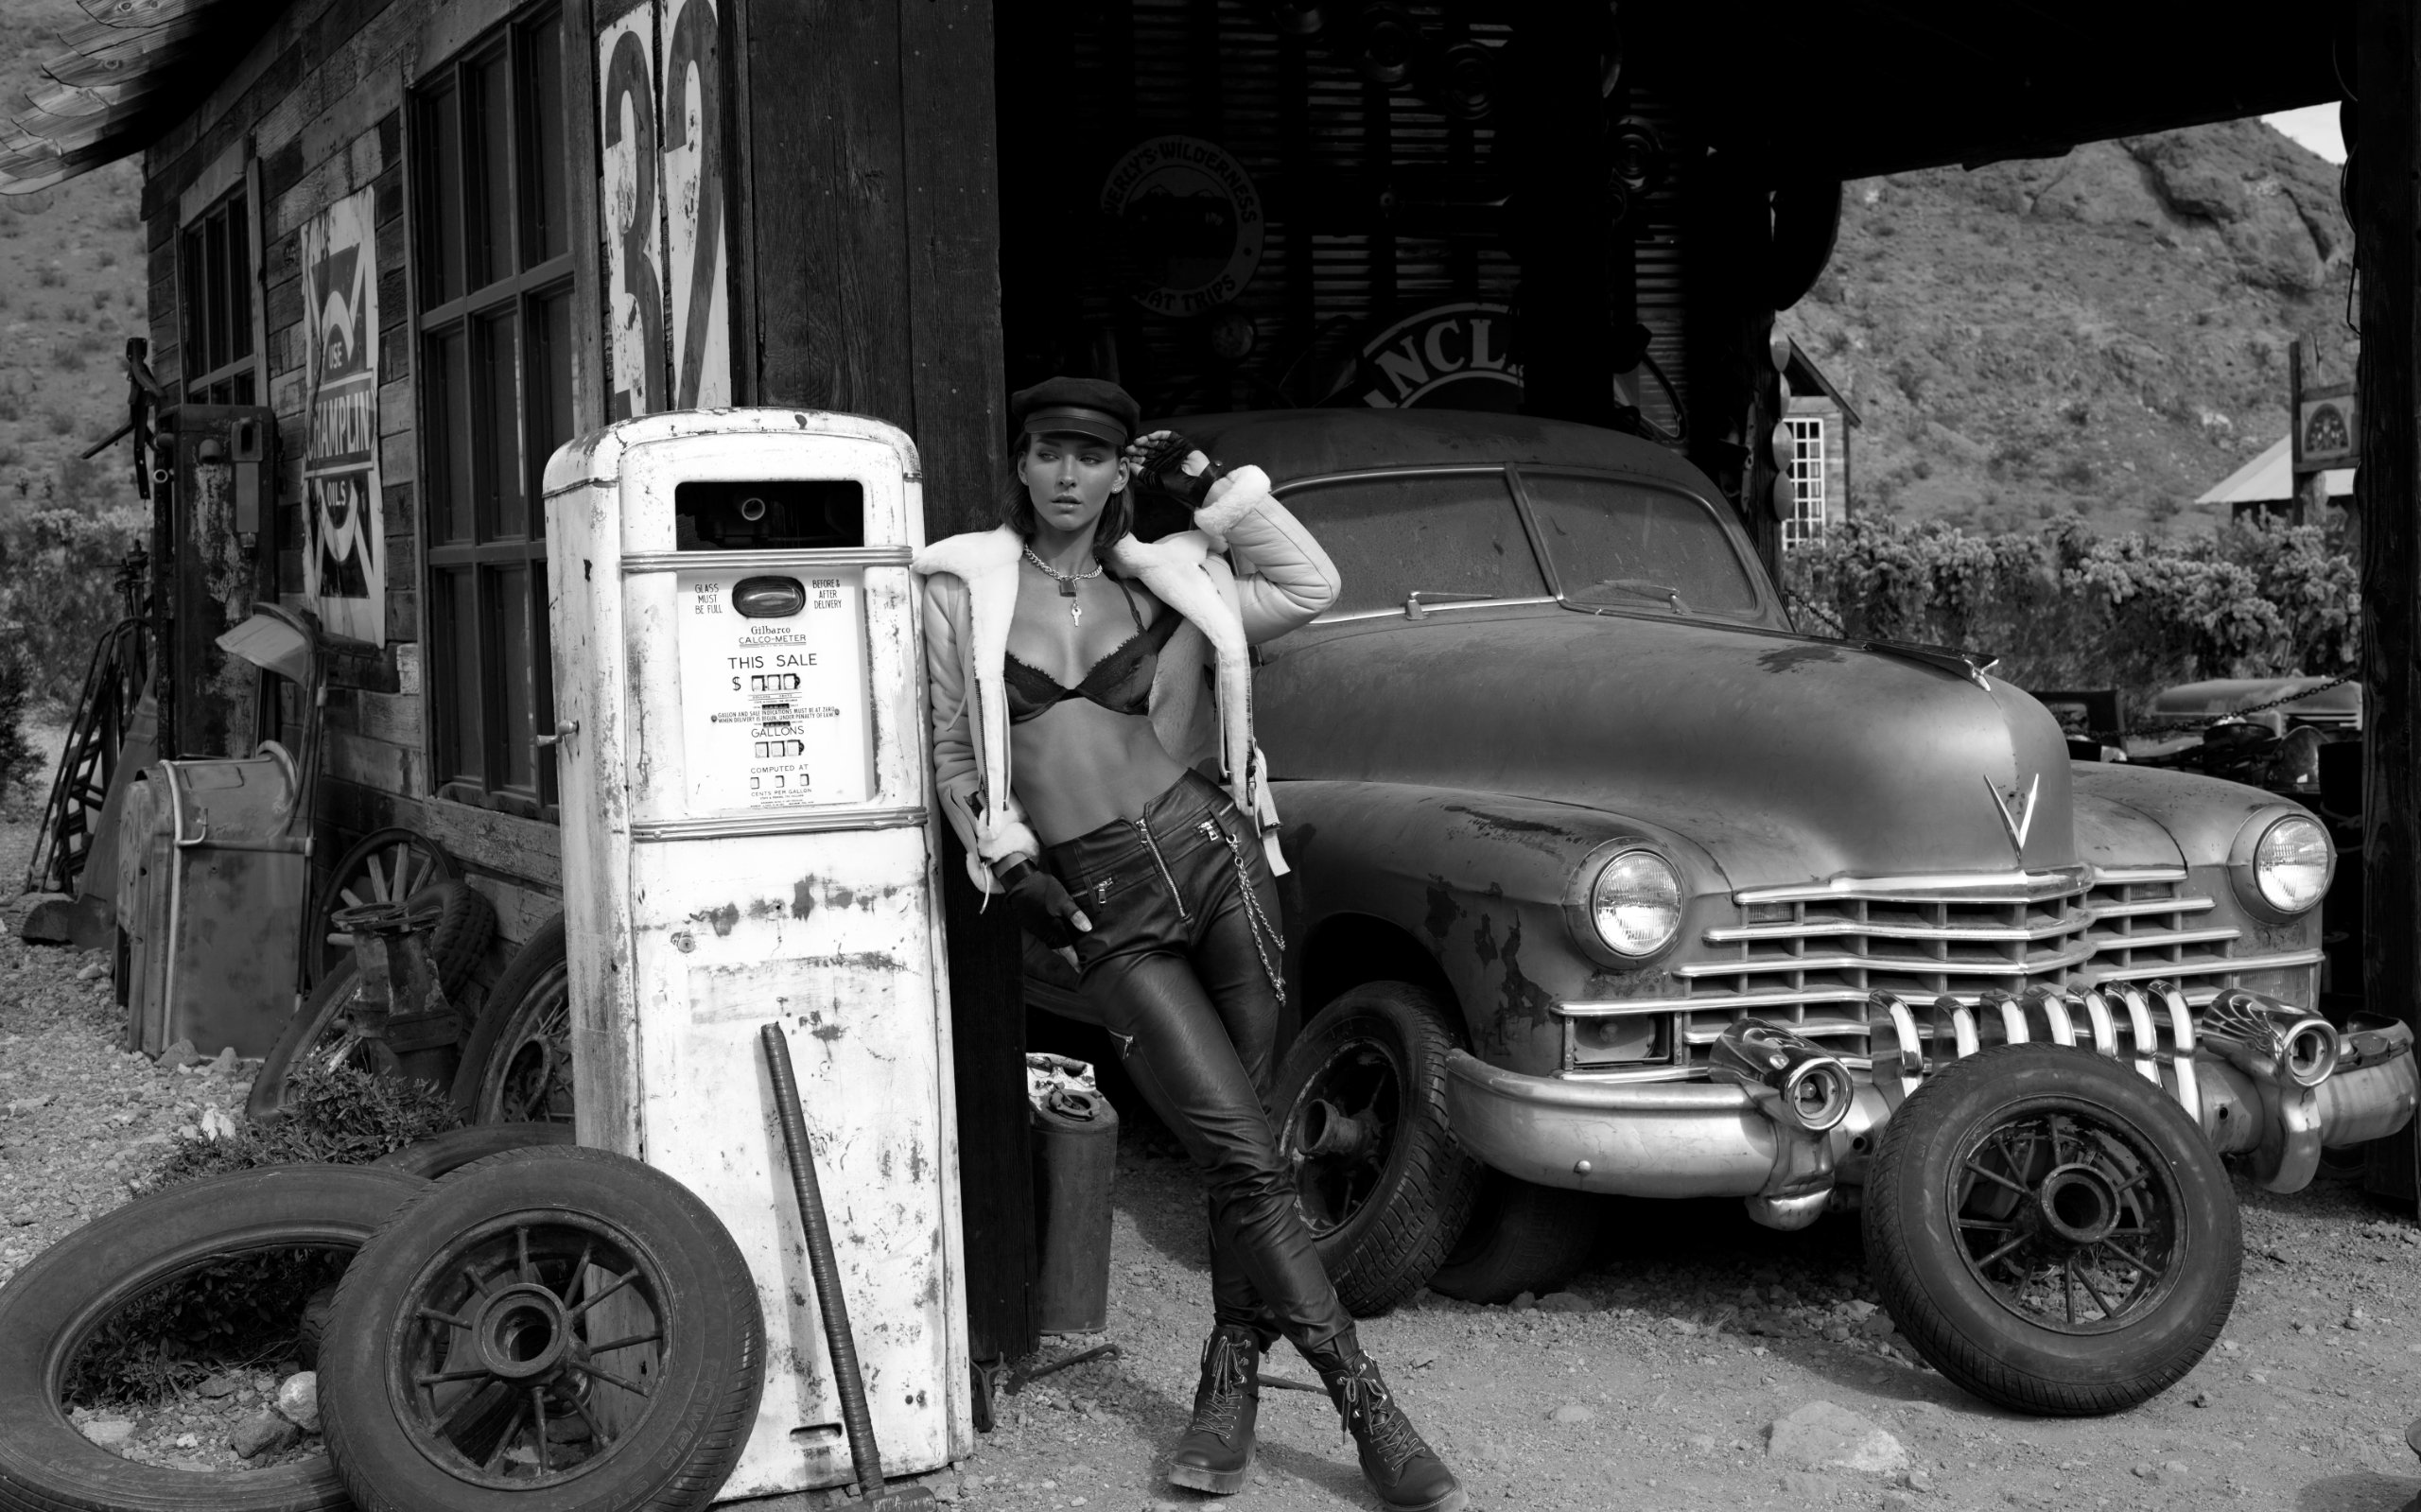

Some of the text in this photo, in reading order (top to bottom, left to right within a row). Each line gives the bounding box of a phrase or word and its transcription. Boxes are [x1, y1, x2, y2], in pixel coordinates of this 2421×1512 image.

[1159, 142, 1257, 223] WILDERNESS
[1181, 275, 1235, 311] TRIPS
[329, 341, 342, 370] USE
[327, 480, 346, 507] OILS
[695, 583, 719, 594] GLASS
[812, 579, 835, 588] BEFORE
[698, 594, 717, 603] MUST
[819, 589, 837, 599] AFTER
[695, 604, 723, 614] BE FULL
[814, 600, 842, 609] DELIVERY
[751, 625, 791, 635] Gilbarco
[739, 634, 807, 645] CALCO-METER
[727, 652, 817, 669] THIS SALE
[732, 676, 741, 691] $
[751, 725, 805, 738] GALLONS
[751, 765, 795, 774] COMPUTED
